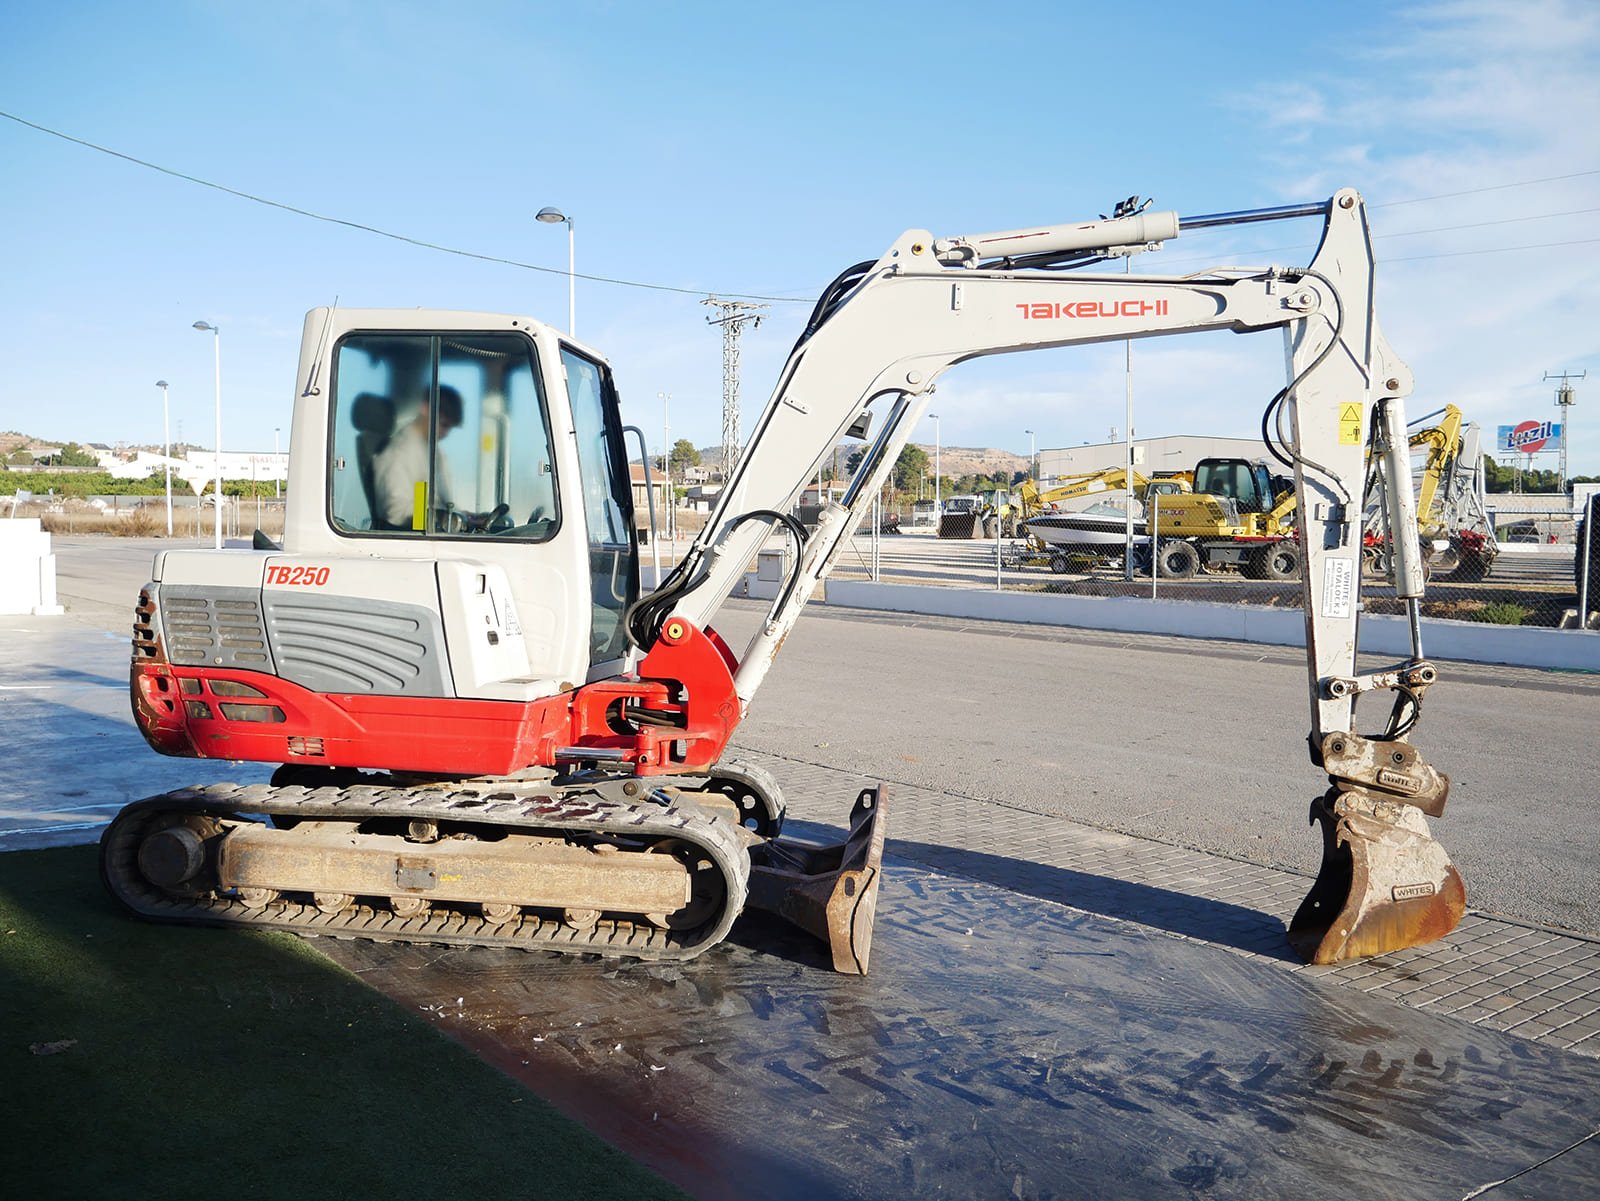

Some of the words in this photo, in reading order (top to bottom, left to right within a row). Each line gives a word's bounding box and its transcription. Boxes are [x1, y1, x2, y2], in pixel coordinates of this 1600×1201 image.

[1016, 300, 1168, 319] TAKEUCHI
[1507, 421, 1551, 448] Luzil
[266, 566, 331, 586] TB250
[1333, 562, 1343, 608] TOTALOCK
[1342, 571, 1351, 606] WHITES
[1397, 885, 1433, 897] WHITES
